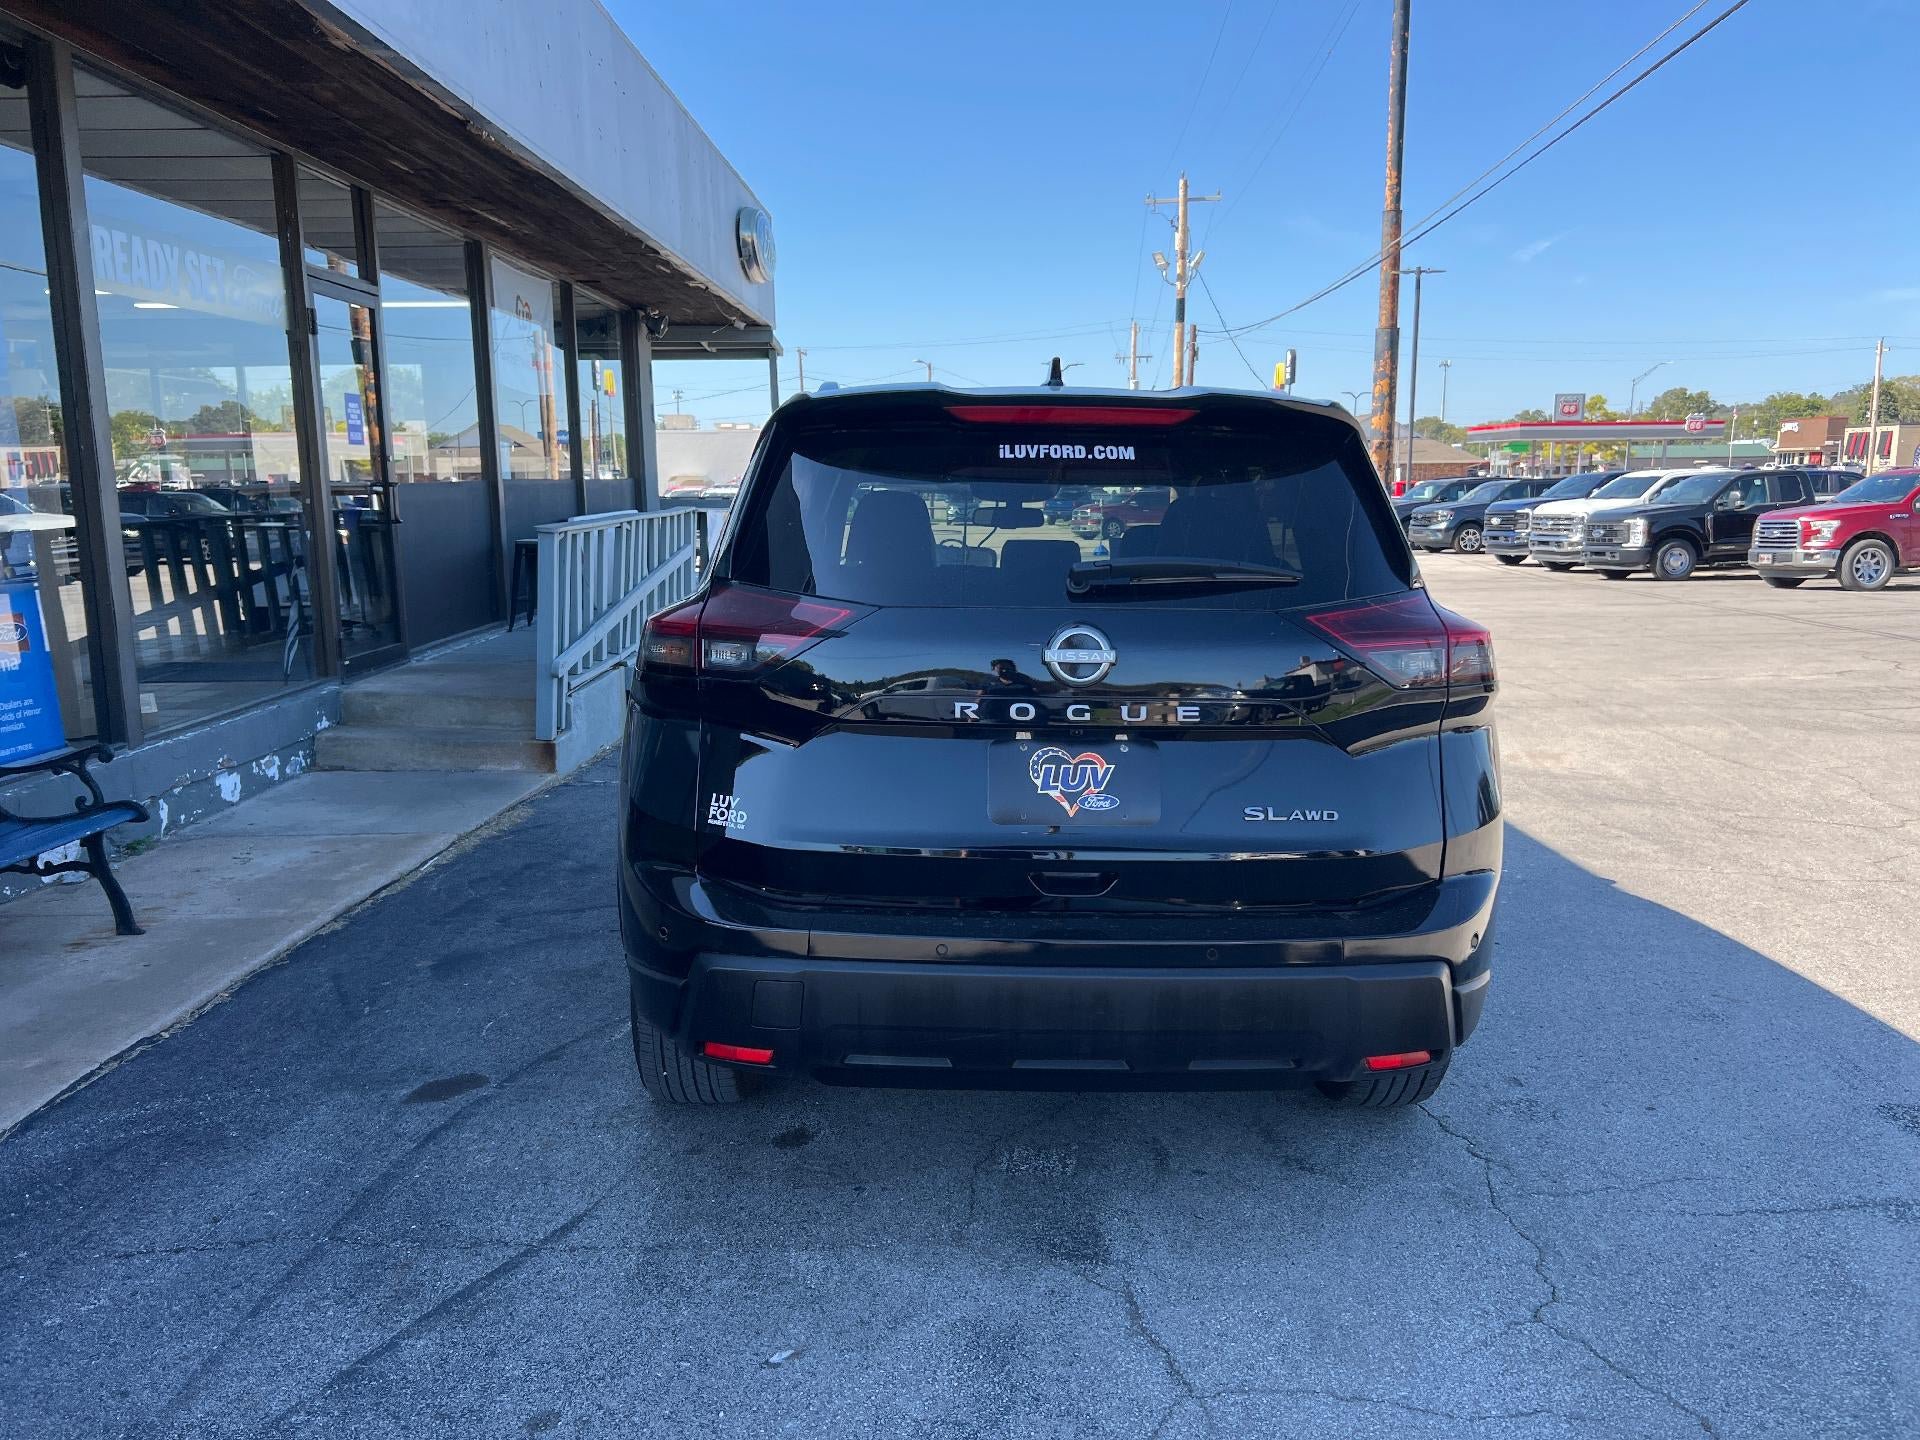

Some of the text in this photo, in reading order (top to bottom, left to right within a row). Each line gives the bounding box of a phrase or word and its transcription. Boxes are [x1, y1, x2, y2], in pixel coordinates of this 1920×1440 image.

[91, 224, 180, 297] READY
[184, 250, 226, 305] SET
[999, 444, 1136, 460] iLUVFORD.COM
[1046, 652, 1114, 661] NISSAN
[24, 708, 42, 717] Honor
[954, 702, 1201, 722] ROGUE
[1037, 764, 1116, 793] LUV
[710, 793, 740, 809] LUV
[1084, 796, 1111, 808] Ford
[709, 806, 747, 823] FORD
[1244, 806, 1339, 821] SL AWD
